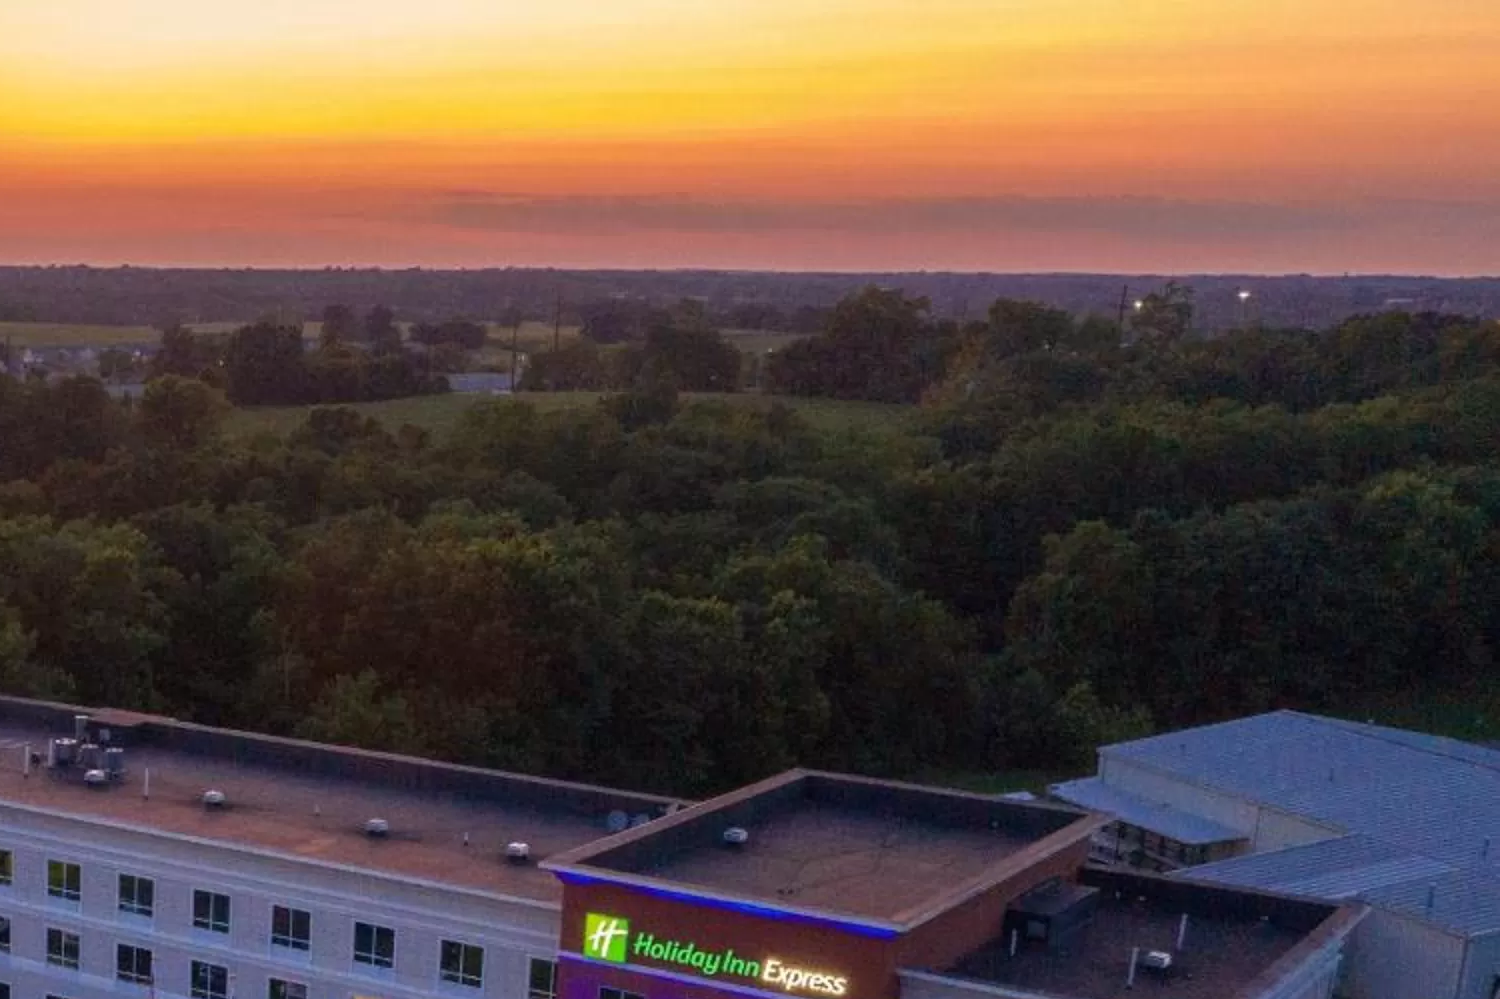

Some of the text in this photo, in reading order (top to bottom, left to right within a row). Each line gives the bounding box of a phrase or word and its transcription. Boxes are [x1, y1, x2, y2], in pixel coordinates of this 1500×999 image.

[634, 932, 846, 995] Holiday Inn Express
